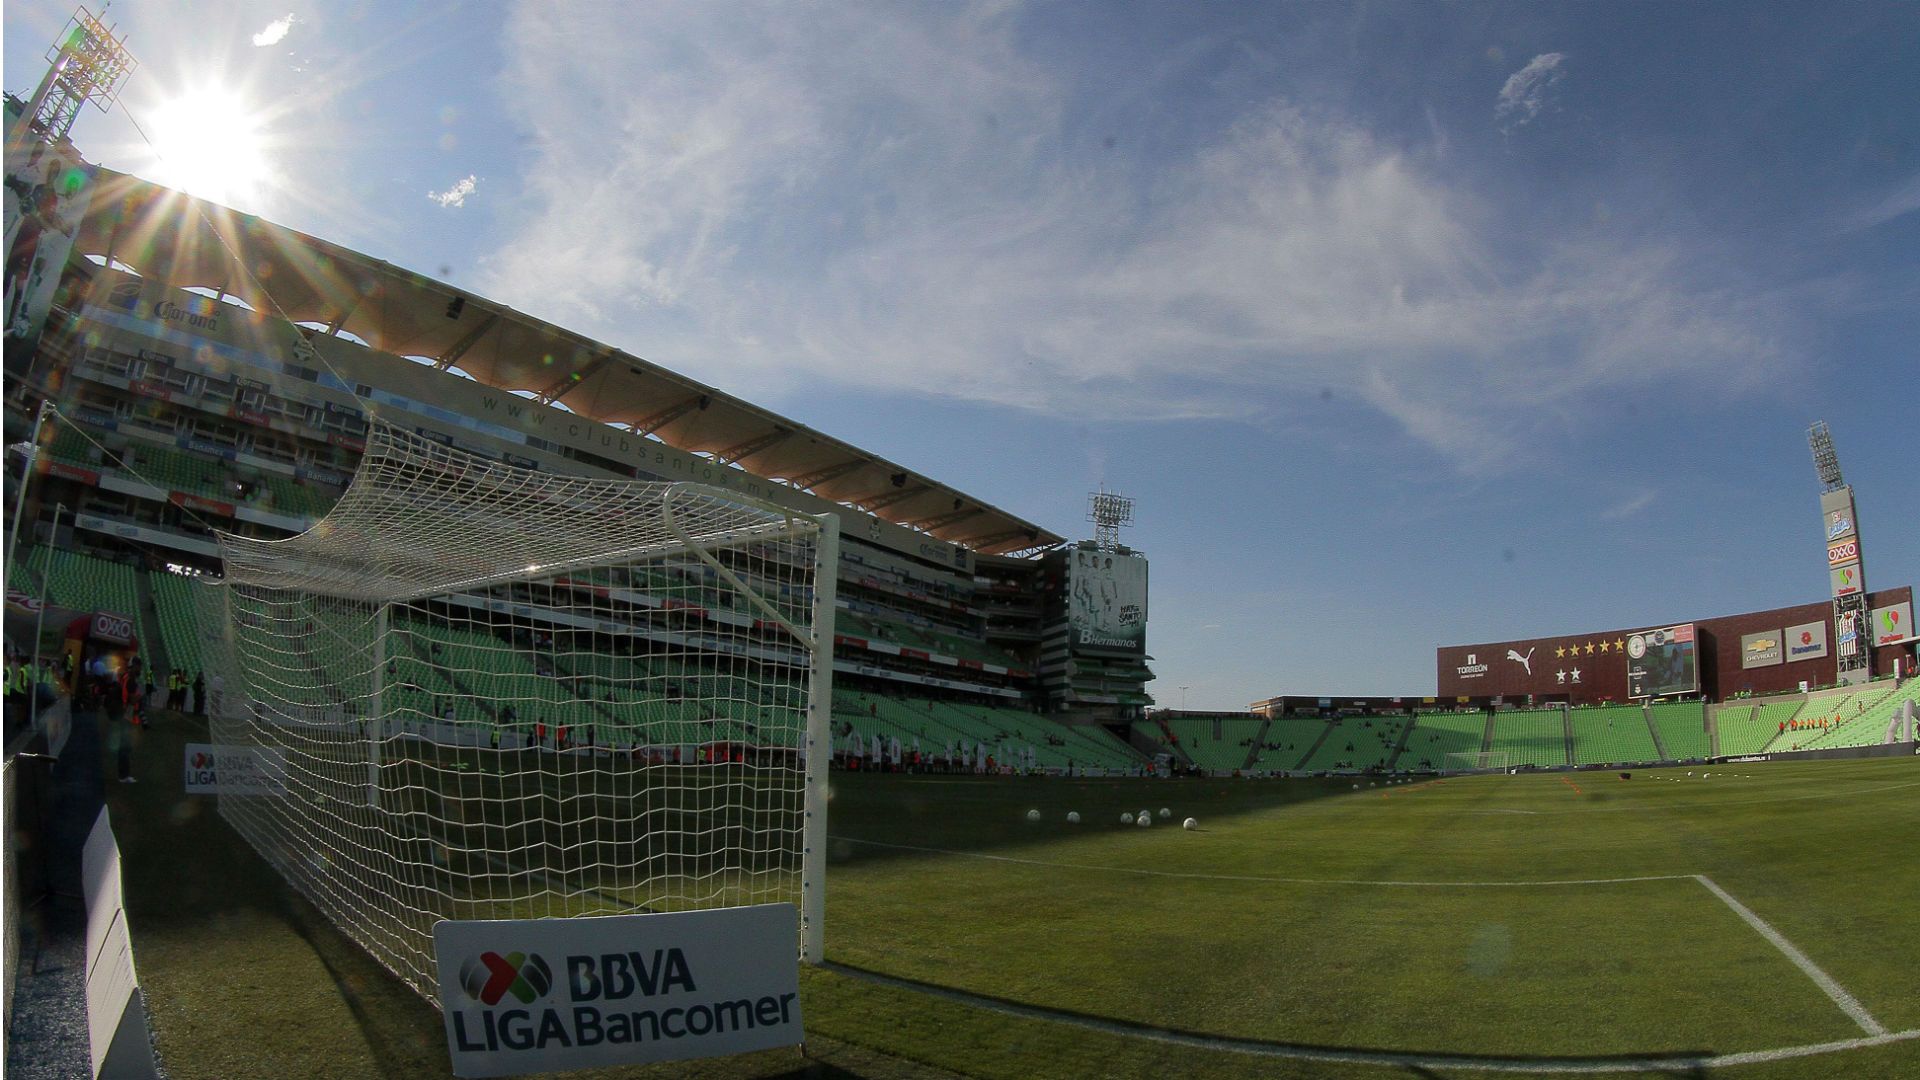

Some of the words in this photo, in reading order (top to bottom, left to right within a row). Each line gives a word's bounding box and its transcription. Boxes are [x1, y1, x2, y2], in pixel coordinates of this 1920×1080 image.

[153, 300, 218, 332] Corona
[1828, 543, 1856, 560] OXXO
[97, 616, 131, 638] OXXO
[1746, 652, 1778, 662] CHEVROLET
[186, 771, 218, 786] LIGA
[566, 947, 697, 1003] BBVA
[452, 1008, 572, 1052] LIGA
[574, 992, 796, 1048] Bancomer
